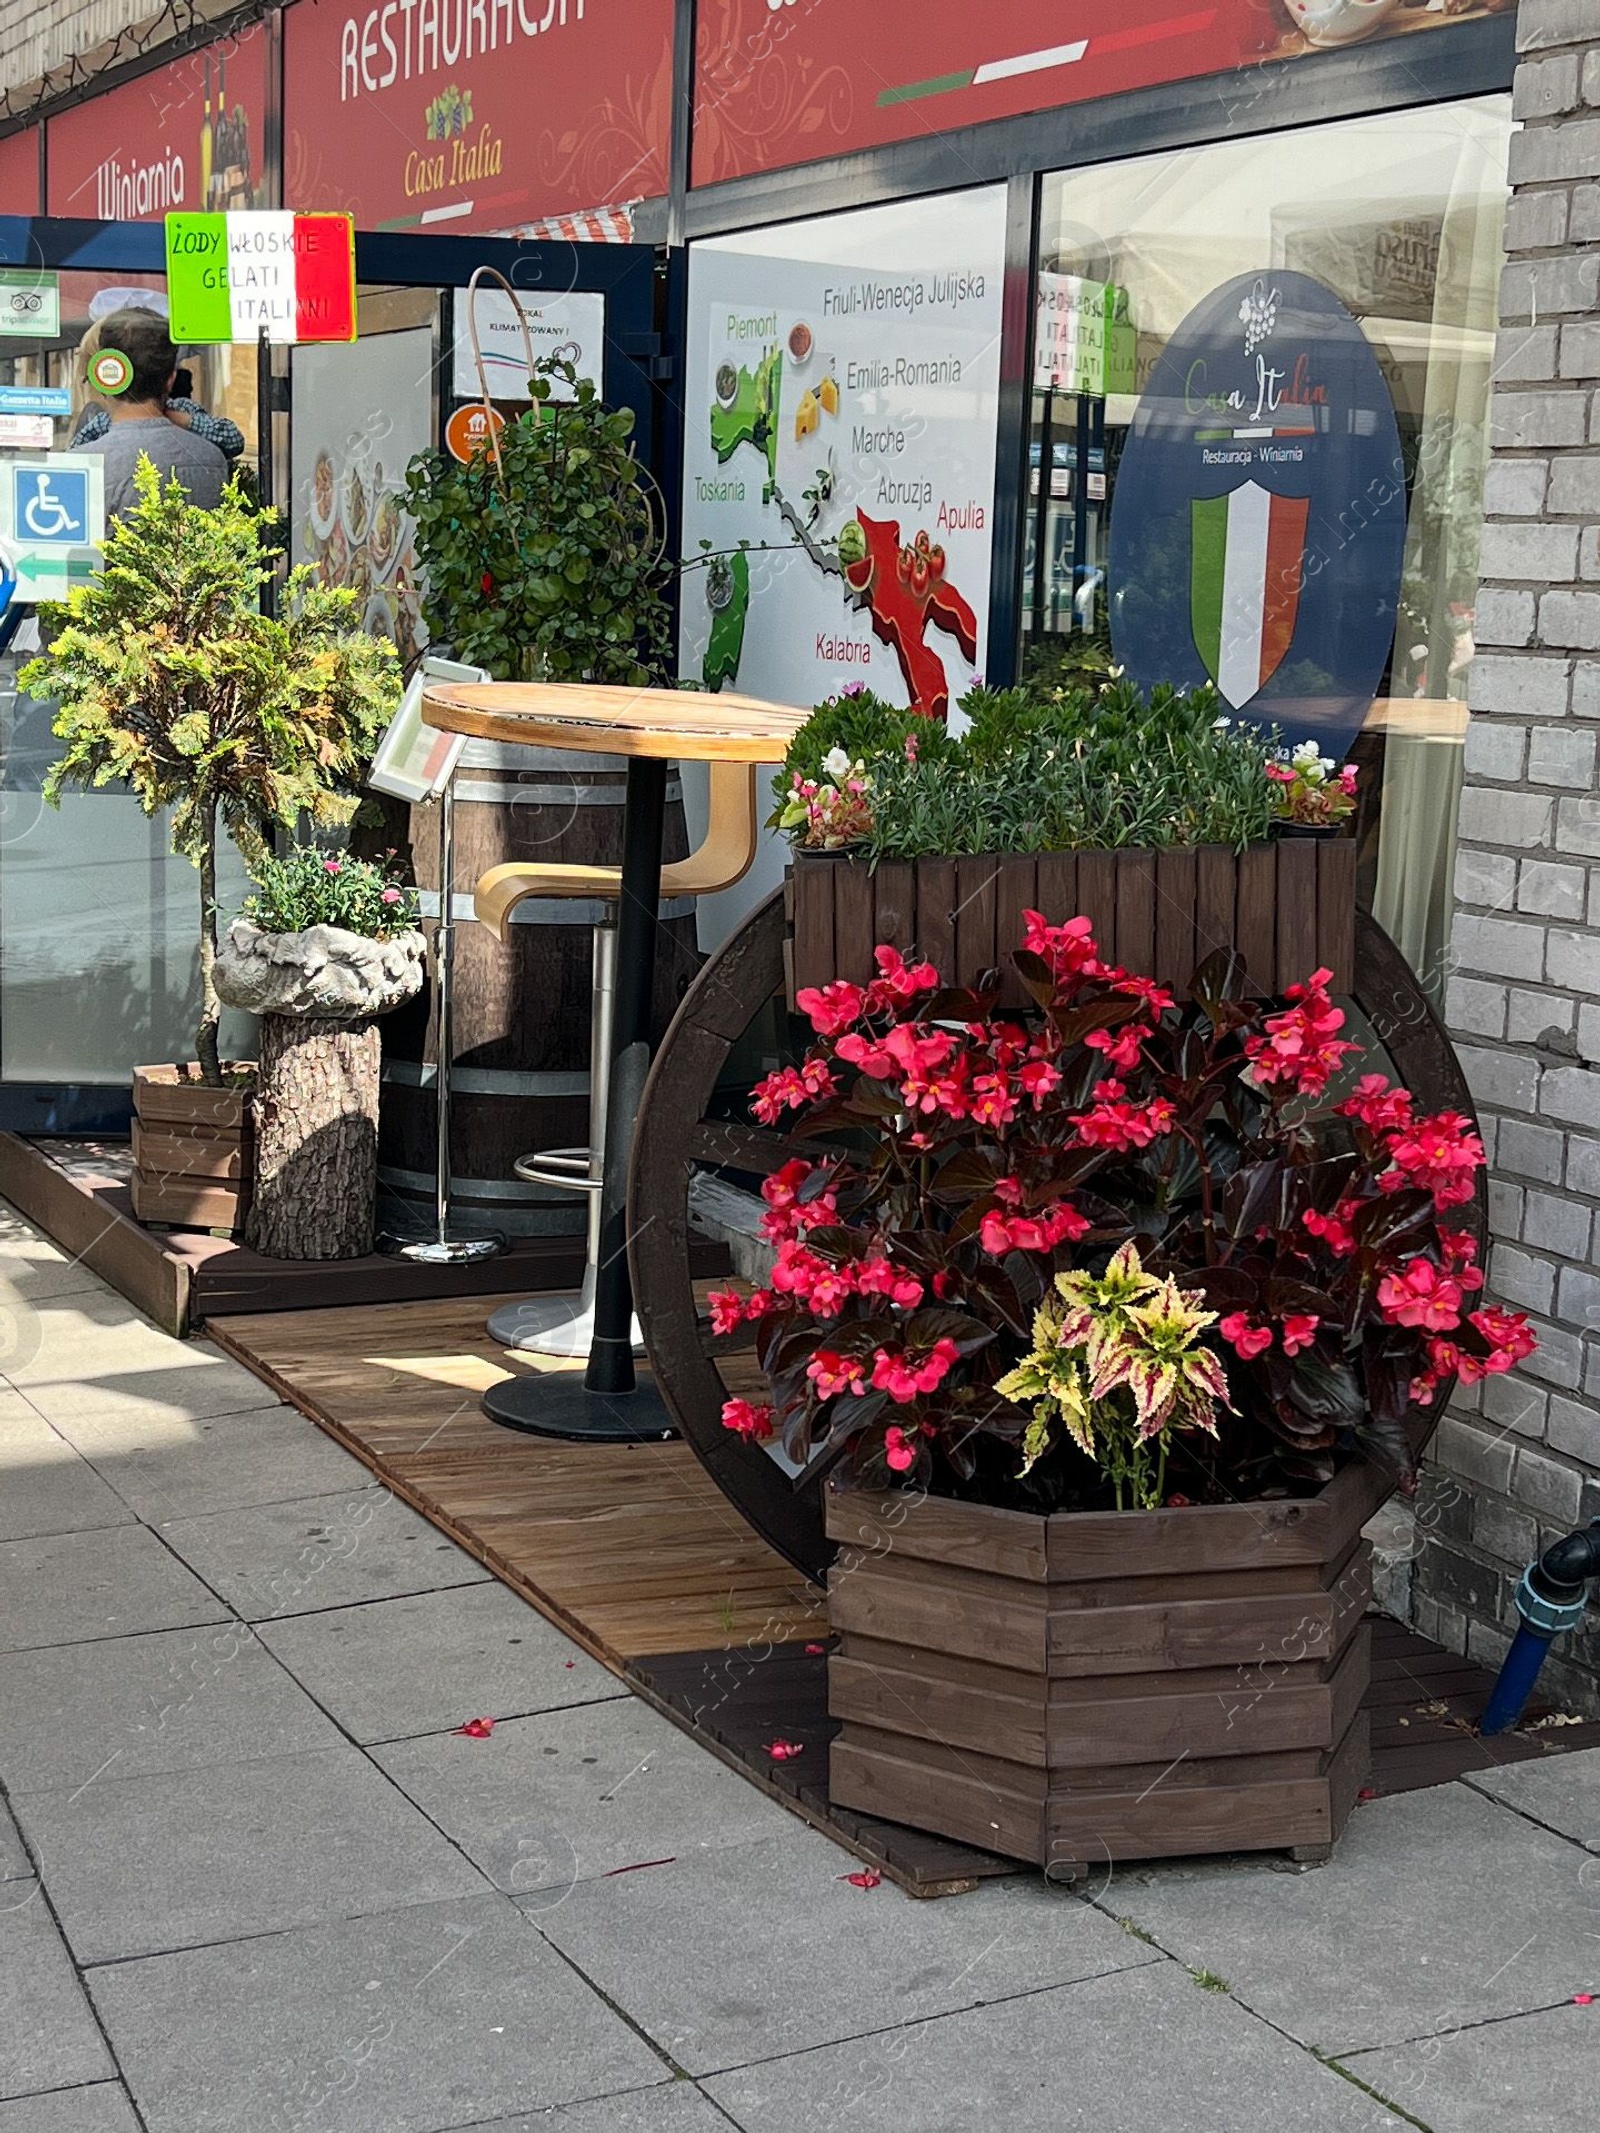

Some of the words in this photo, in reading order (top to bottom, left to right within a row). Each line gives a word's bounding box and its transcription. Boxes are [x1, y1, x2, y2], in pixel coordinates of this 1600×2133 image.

[341, 0, 584, 102] RESTAURA
[404, 150, 445, 197] Casa
[448, 124, 503, 187] Italia
[98, 146, 185, 221] Winiarnia
[203, 266, 279, 289] GELATI
[823, 278, 924, 317] Friuli-Wenecja
[928, 273, 985, 308] Julijska
[518, 309, 543, 318] OKAL
[727, 311, 777, 340] Piemont
[847, 354, 961, 389] Emilia-Romania
[1185, 359, 1246, 415] Casa
[1248, 353, 1327, 421] Italia
[852, 425, 904, 453] Marche
[695, 476, 745, 502] Toskania
[877, 476, 932, 511] Abruzja
[937, 500, 984, 535] Apulia
[816, 633, 870, 663] Kalabria
